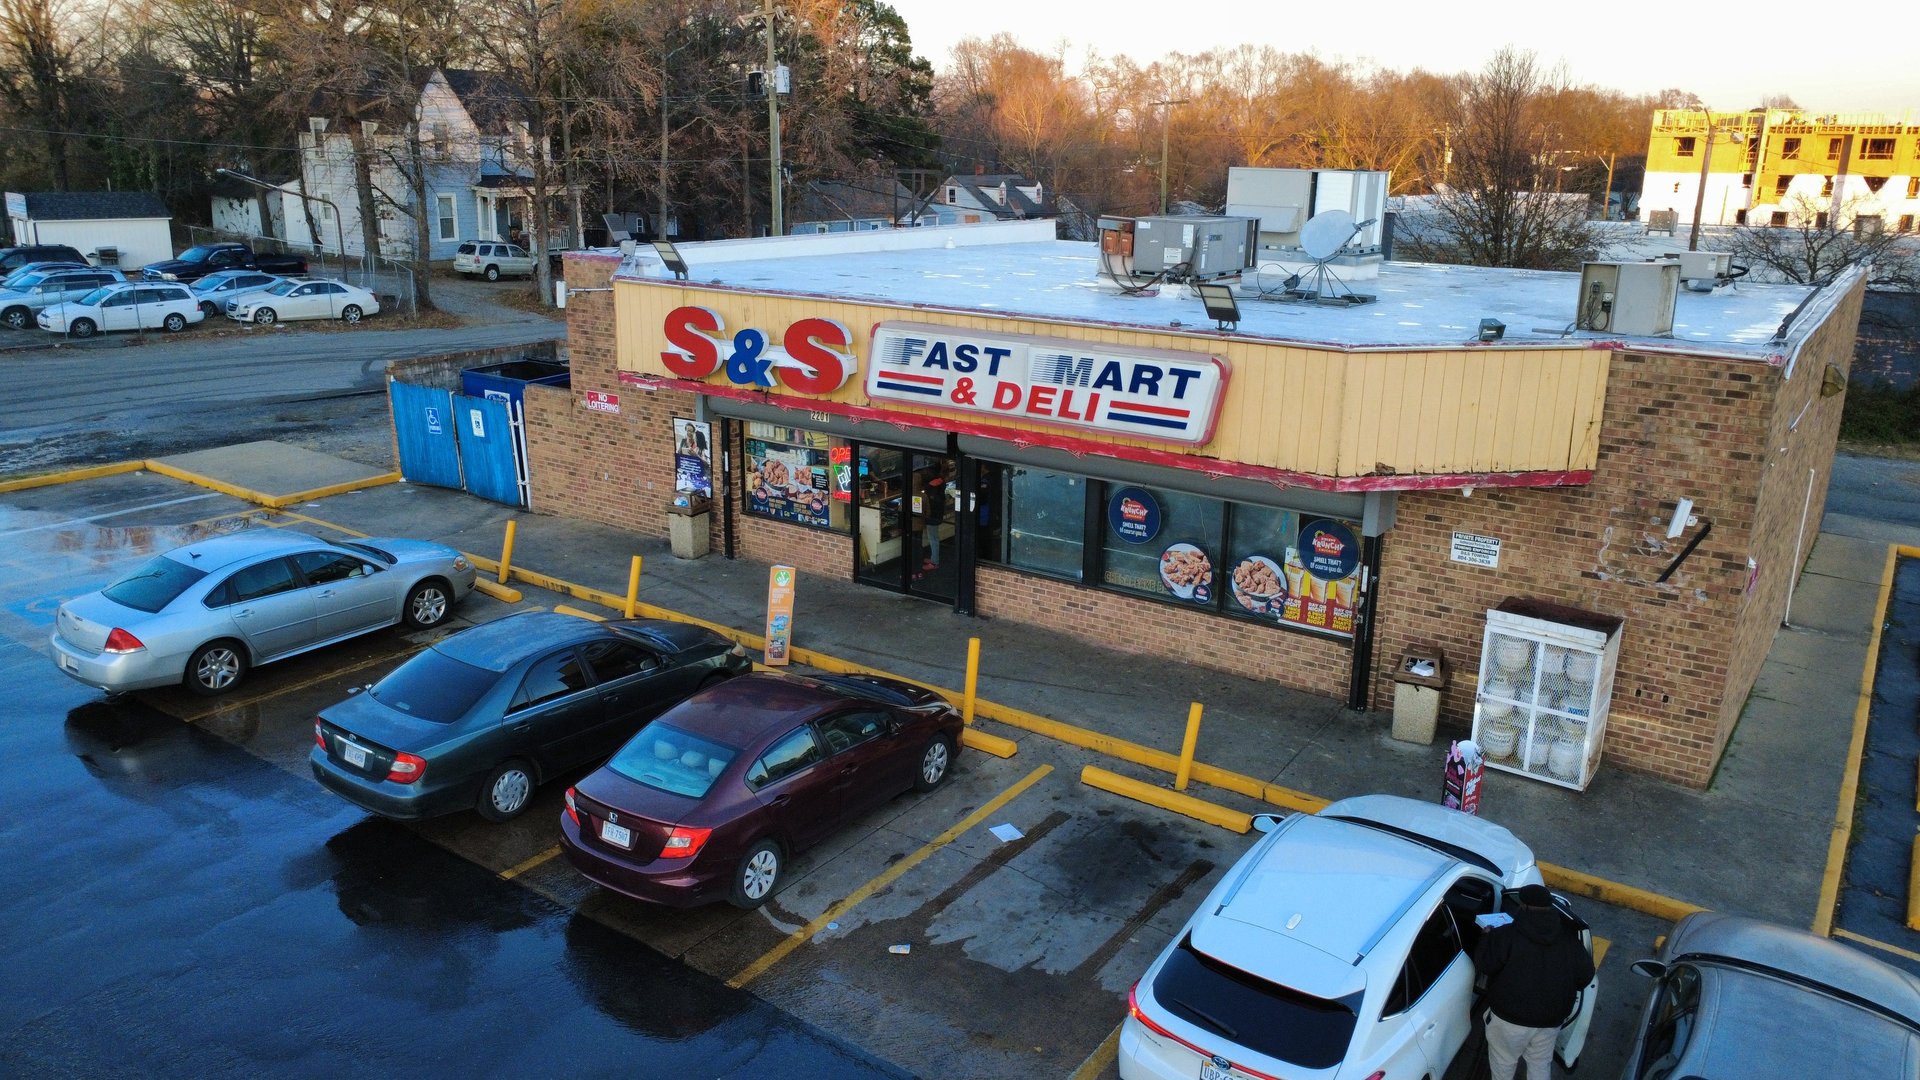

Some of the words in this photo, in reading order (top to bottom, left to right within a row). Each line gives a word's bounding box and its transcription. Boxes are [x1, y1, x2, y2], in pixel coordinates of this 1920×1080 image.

[660, 306, 852, 394] S&S
[884, 336, 1011, 376] FAST
[1032, 354, 1201, 399] MART
[598, 393, 607, 402] NO
[951, 377, 977, 405] &
[992, 381, 1100, 422] DELI
[588, 400, 618, 413] LOITERING
[812, 411, 829, 422] 2201
[831, 446, 851, 460] OPE
[1121, 505, 1148, 516] KRUNCHY
[1312, 538, 1344, 551] KRUNCHY
